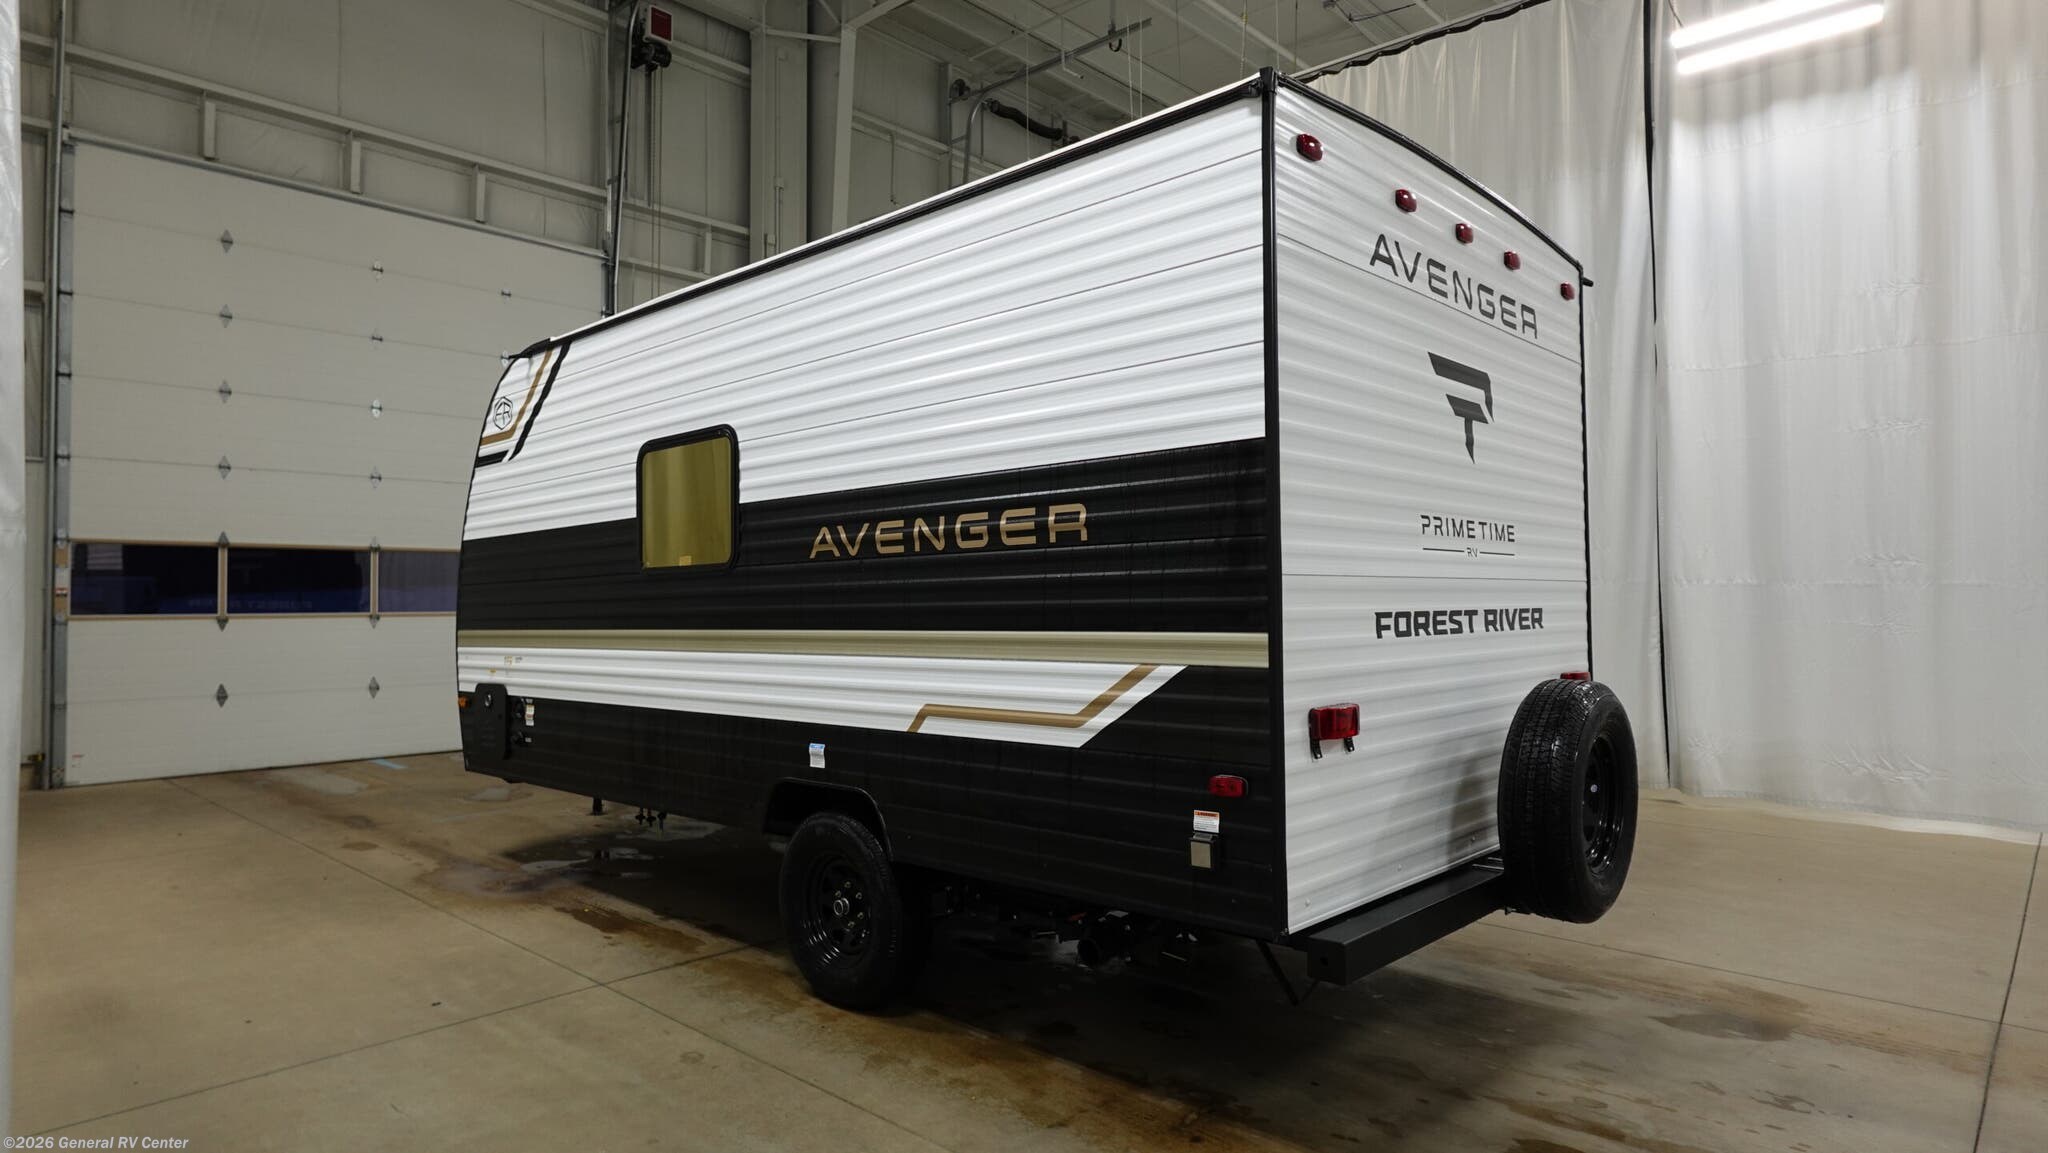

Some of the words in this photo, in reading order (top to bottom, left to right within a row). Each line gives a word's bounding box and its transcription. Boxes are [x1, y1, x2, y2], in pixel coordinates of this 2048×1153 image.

[1369, 233, 1538, 339] AVENGER
[810, 503, 1088, 558] AVENGER
[1466, 547, 1478, 558] RV
[1374, 609, 1479, 639] FOREST
[1483, 607, 1544, 633] RIVER
